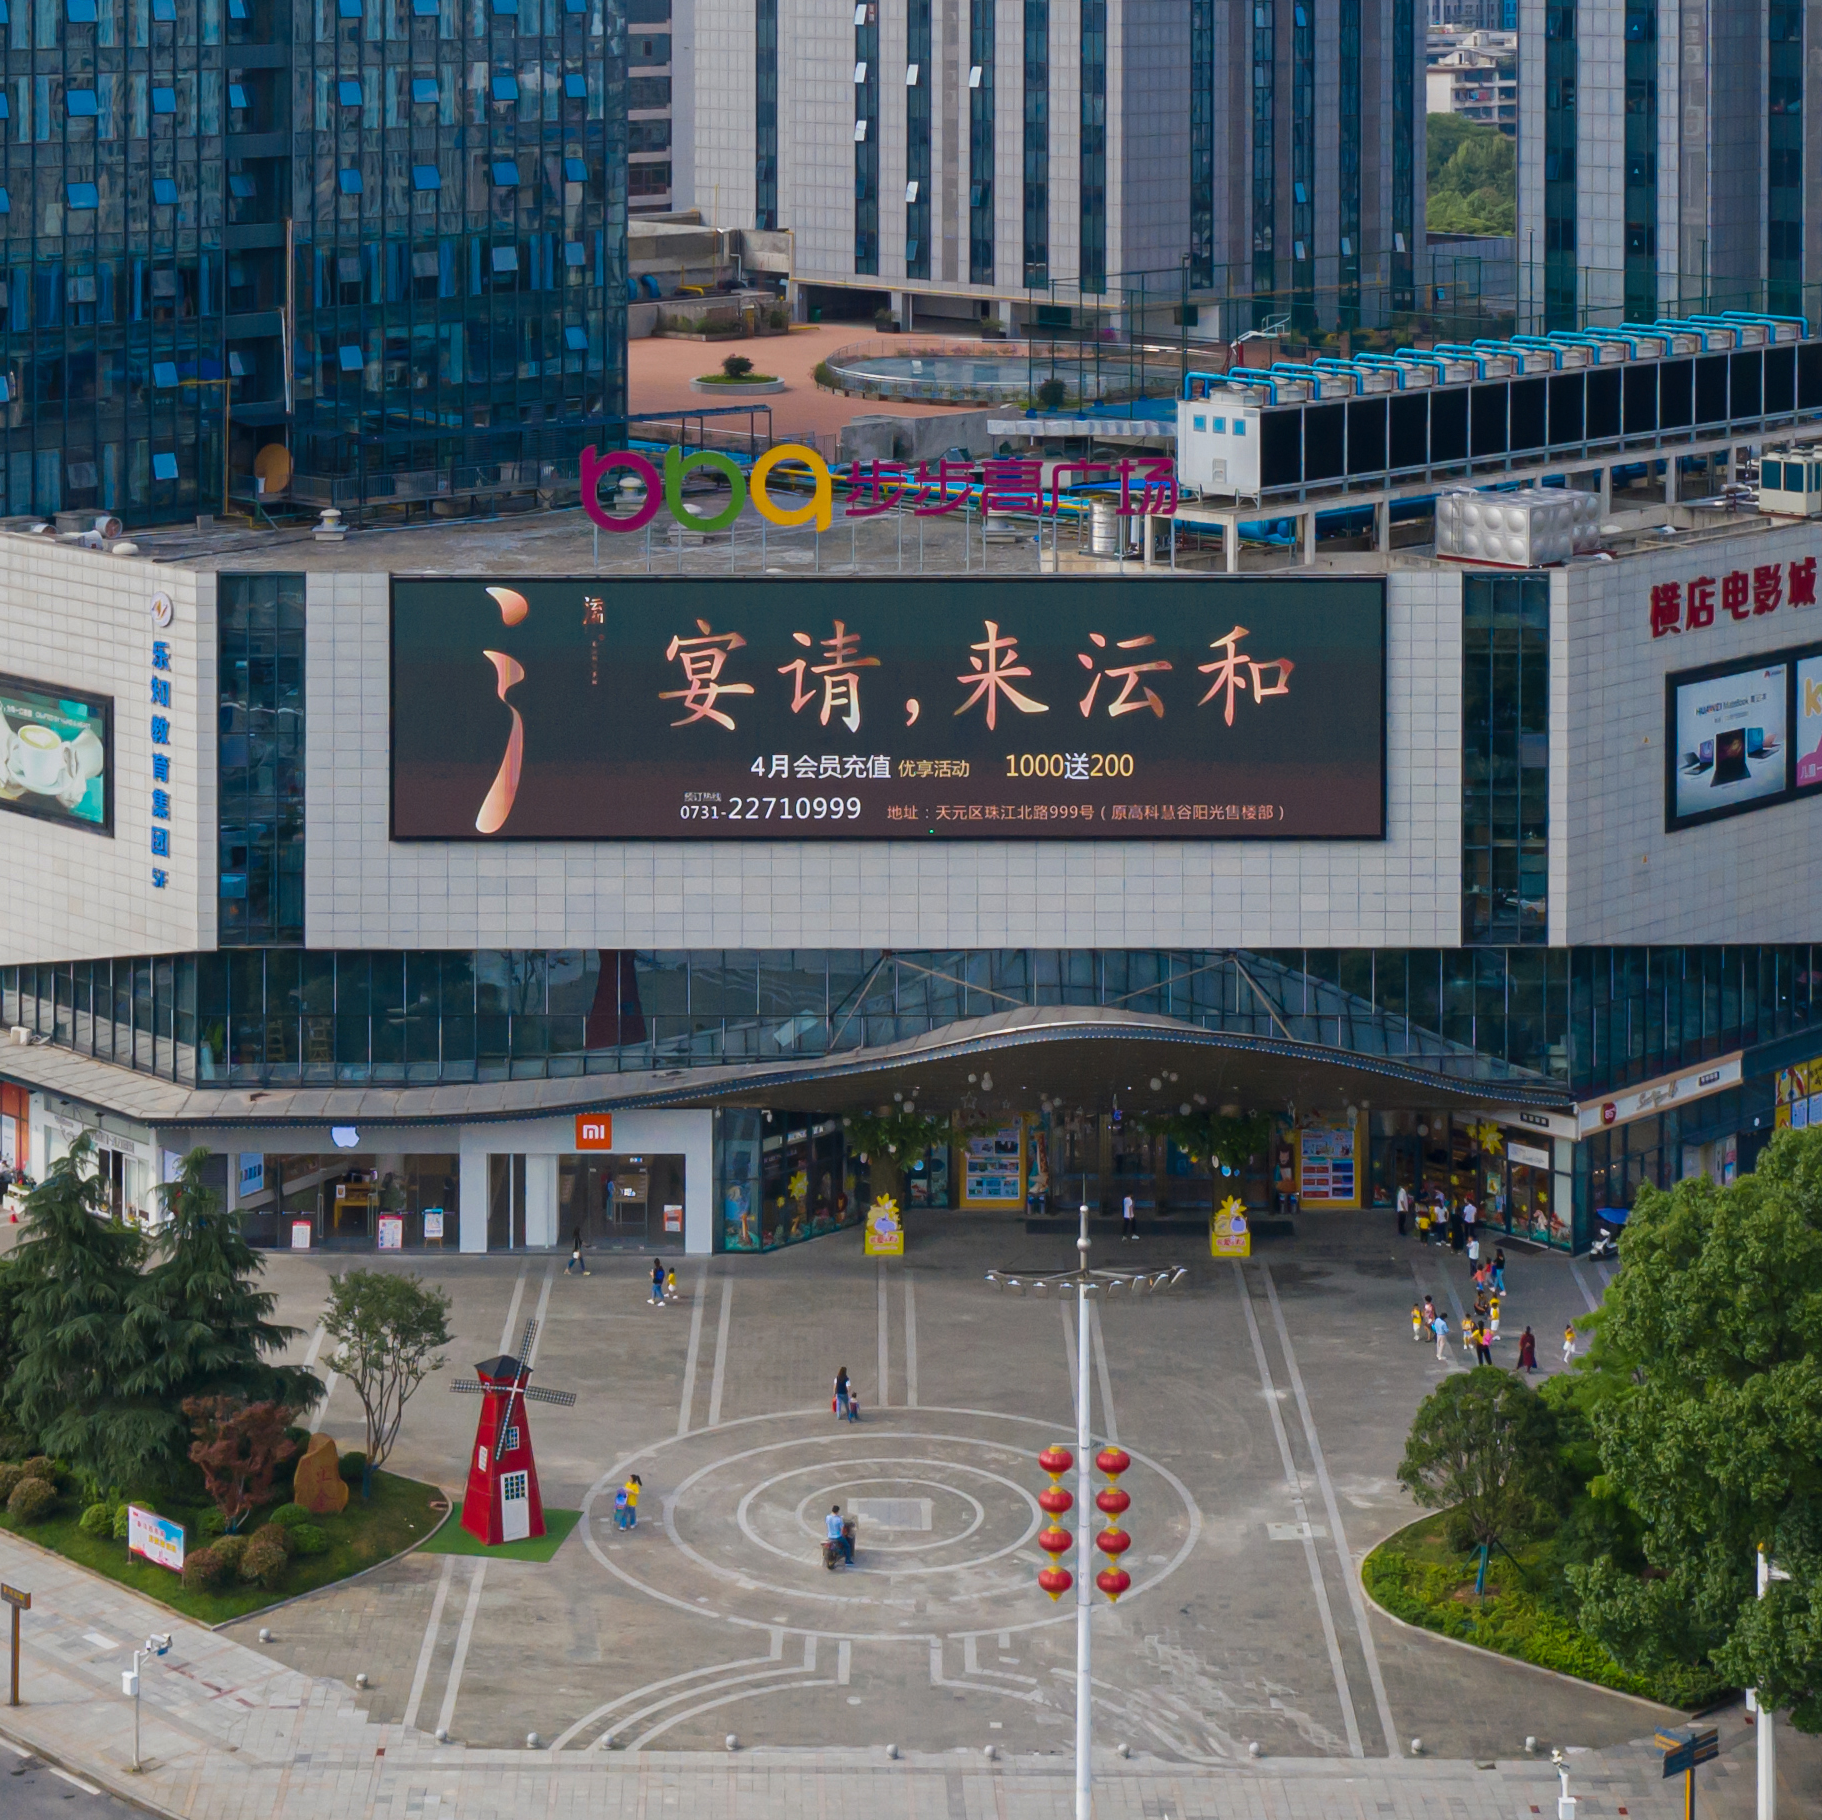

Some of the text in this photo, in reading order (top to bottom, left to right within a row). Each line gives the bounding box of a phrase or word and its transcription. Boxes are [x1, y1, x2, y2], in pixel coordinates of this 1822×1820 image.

[845, 456, 1178, 517] 步步高广场
[1650, 556, 1817, 639] 横店电影城
[150, 641, 171, 859] 乐知教育集团
[750, 753, 1134, 780] 4月会员充值 优享活动 1000送200
[680, 795, 862, 821] 0731-22710999
